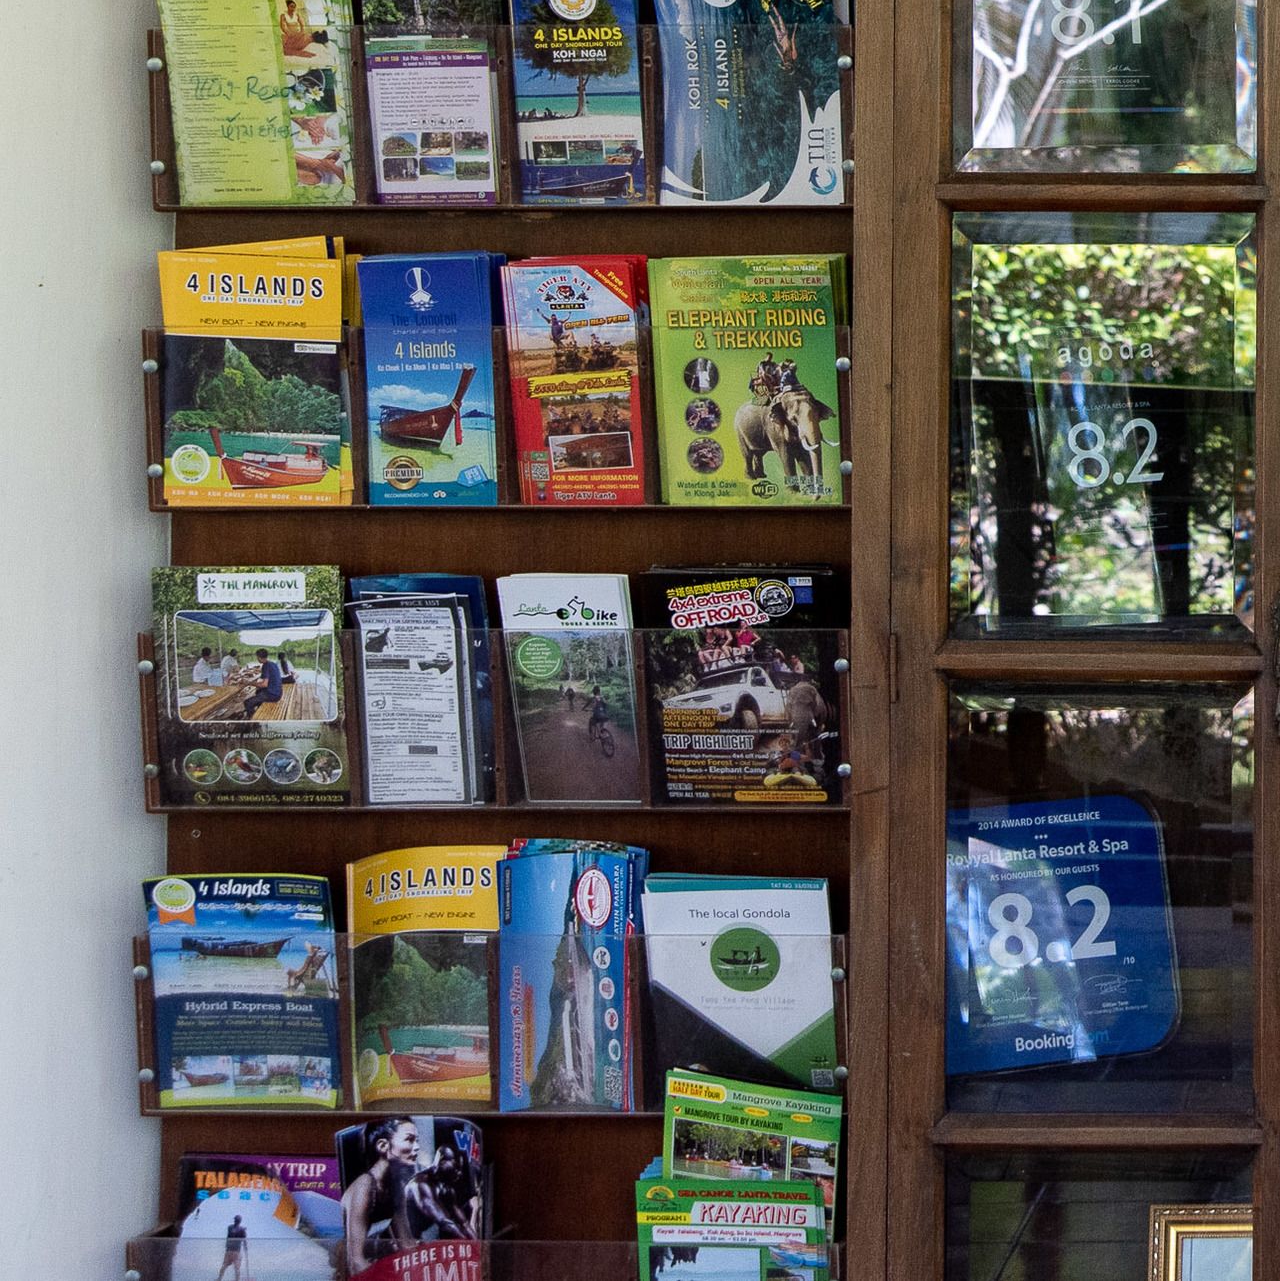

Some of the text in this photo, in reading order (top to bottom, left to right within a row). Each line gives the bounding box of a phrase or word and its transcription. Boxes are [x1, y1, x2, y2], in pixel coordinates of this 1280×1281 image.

[534, 27, 623, 42] 4 ISLANDS
[553, 49, 607, 59] KOH NGAI
[685, 39, 701, 111] KOH ROK
[714, 39, 730, 93] ISLAND
[186, 273, 325, 299] 4 ISLANDS
[753, 277, 822, 285] OPEN ALL YEAR
[237, 296, 284, 305] SNORKELING
[200, 317, 275, 328] NEW BOAT NEW
[667, 308, 827, 328] ELEPHANT RIDING
[694, 329, 803, 349] & TREKKING
[395, 341, 456, 359] 4 Islands
[1057, 342, 1154, 368] agoda
[1091, 403, 1111, 411] LANTA
[1067, 417, 1165, 488] 8.2
[384, 469, 423, 479] PREMIUM
[590, 474, 639, 482] INFORMATION
[718, 481, 737, 490] Cave
[669, 589, 751, 611] 4x4 extreme
[674, 603, 756, 628] OFF ROAD
[663, 735, 754, 750] TRIP HIGHLIGHT
[666, 758, 733, 767] Mangrove Forest
[743, 766, 767, 775] Camp
[978, 811, 1101, 831] 2014 AWARD OF EXCELLENCE
[997, 838, 1130, 862] Lanta Resort & Spa
[364, 867, 492, 897] 4 ISLANDS
[990, 864, 1100, 882] AS HONOURED BY OUR GUESTS
[213, 878, 272, 897] Islands
[688, 908, 791, 919] The local Gondola
[988, 884, 1117, 968] 8.2
[1123, 956, 1136, 966] /10
[185, 1000, 315, 1014] Hybrid Express Boat
[732, 1092, 832, 1115] Mangrove Kayaking
[285, 1162, 327, 1178] TRIP
[700, 1203, 808, 1226] KAYAKING
[393, 1243, 473, 1270] THERE IS NO
